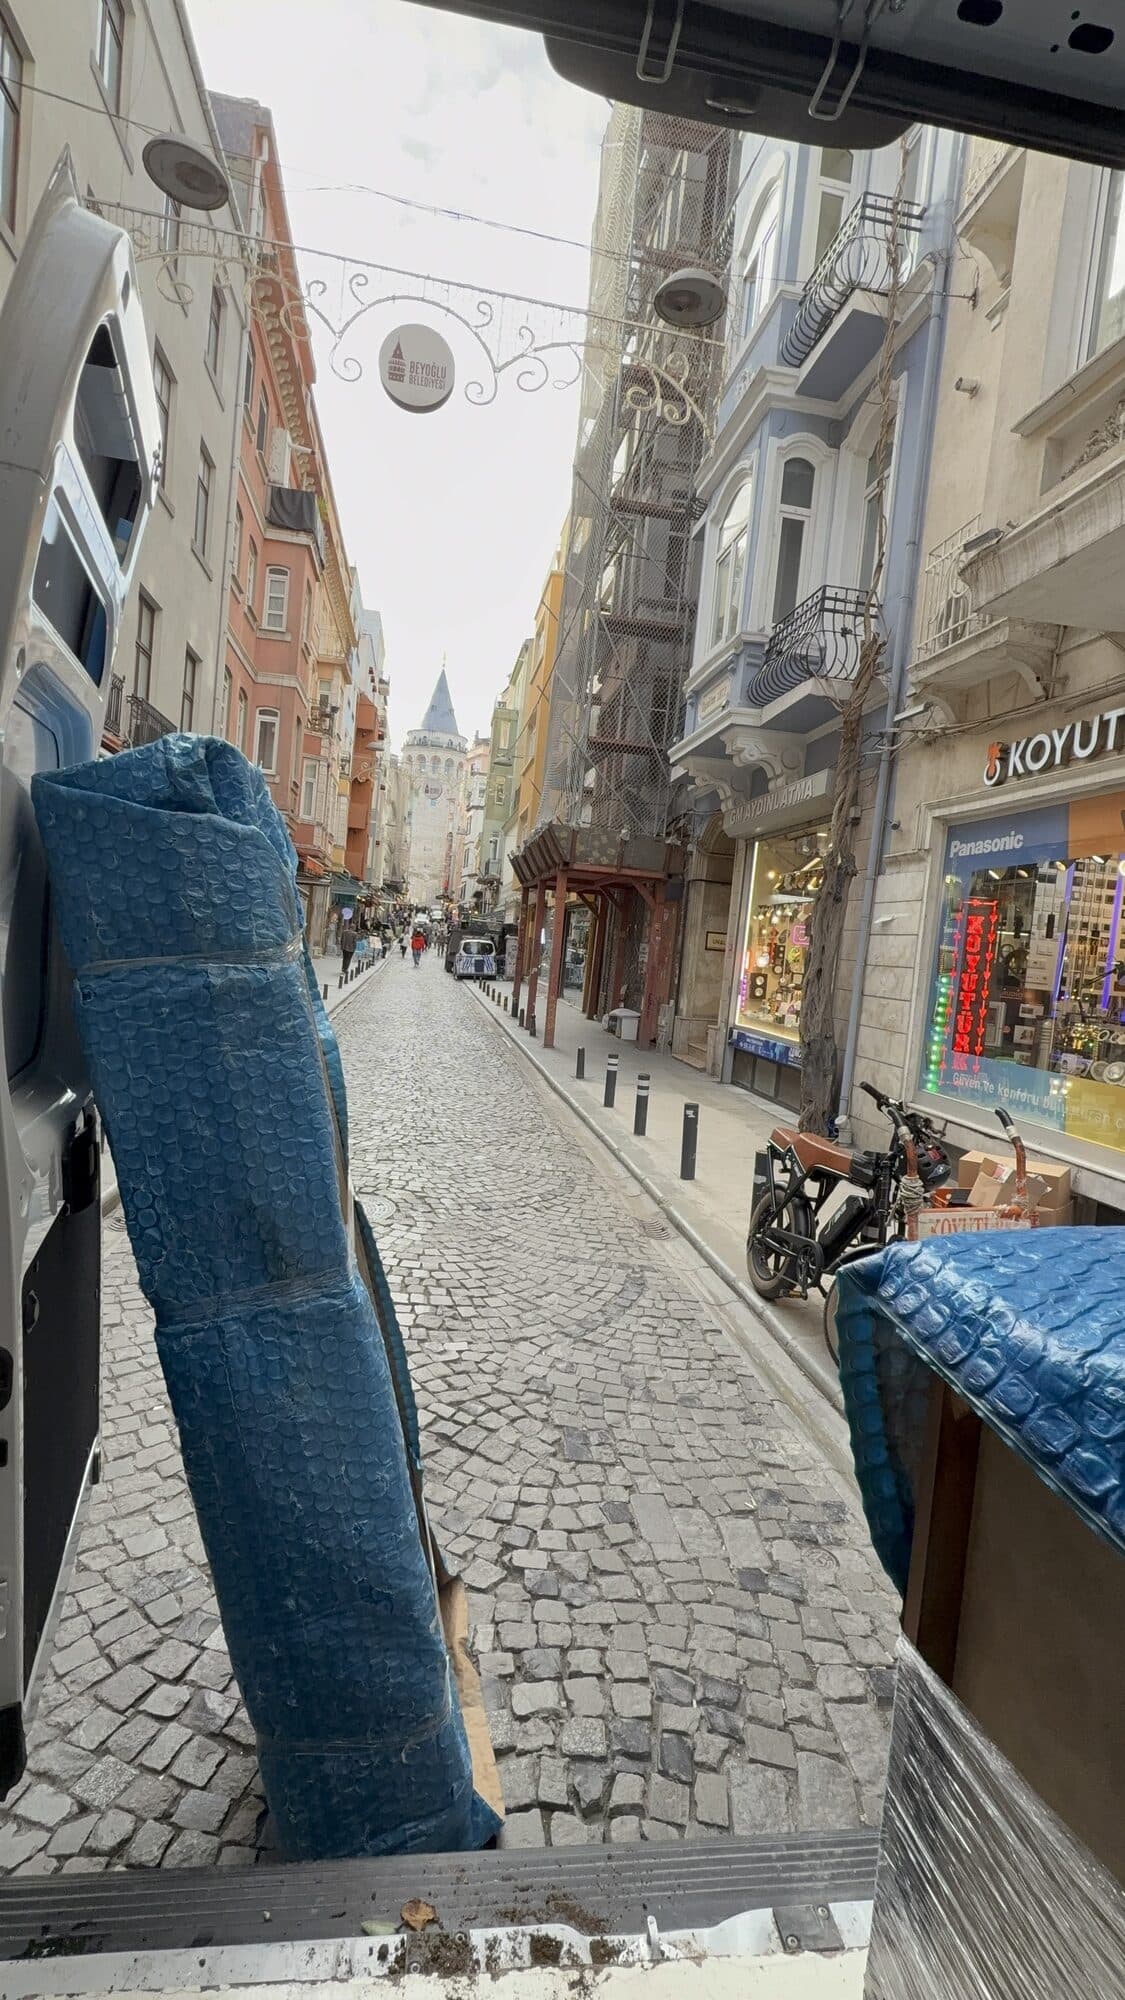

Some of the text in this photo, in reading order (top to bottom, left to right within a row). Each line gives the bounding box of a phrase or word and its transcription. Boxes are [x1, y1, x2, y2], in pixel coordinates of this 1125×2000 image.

[409, 360, 447, 379] BEYOĞLU
[1008, 707, 1125, 777] KOYUT
[744, 779, 812, 820] AYDINLATMA
[950, 830, 1024, 858] Panasonic
[952, 915, 985, 1071] KOYUTÜRK
[952, 1072, 981, 1090] Güven
[997, 1083, 1040, 1106] konforu
